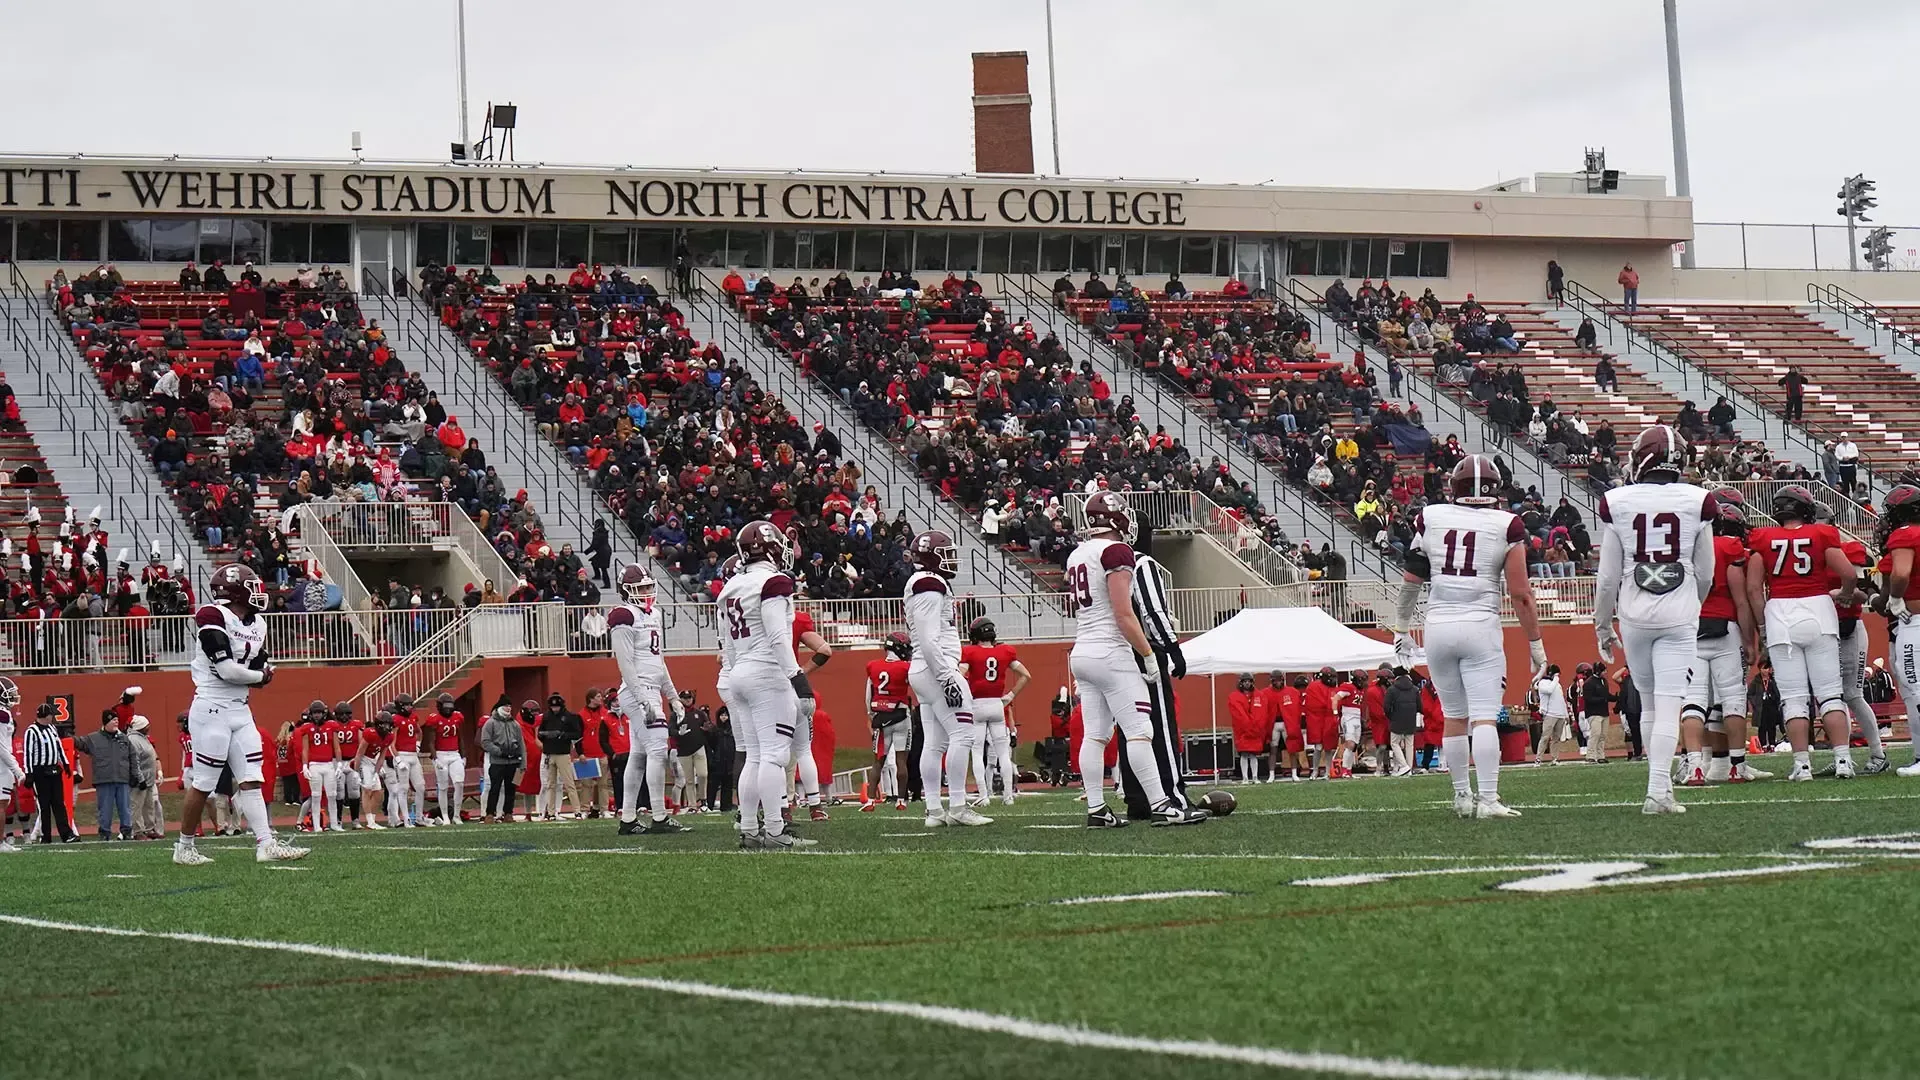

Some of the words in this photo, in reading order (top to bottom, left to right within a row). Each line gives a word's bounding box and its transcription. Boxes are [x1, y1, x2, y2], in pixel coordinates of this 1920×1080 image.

[340, 174, 556, 214] STADIUM
[605, 180, 769, 218] NORTH
[782, 183, 987, 221] CENTRAL
[998, 188, 1187, 226] COLLEGE
[1441, 529, 1477, 577] 11
[1632, 512, 1680, 562] 13
[1771, 538, 1812, 575] 75
[726, 597, 751, 640] 51
[985, 657, 998, 681] 8
[1856, 651, 1866, 689] CARDINALS
[1904, 643, 1914, 685] CARDINALS
[878, 671, 890, 695] 2
[54, 697, 70, 722] 3
[314, 732, 328, 746] 81
[338, 730, 353, 743] 92
[408, 724, 414, 737] 9
[443, 724, 457, 737] 21
